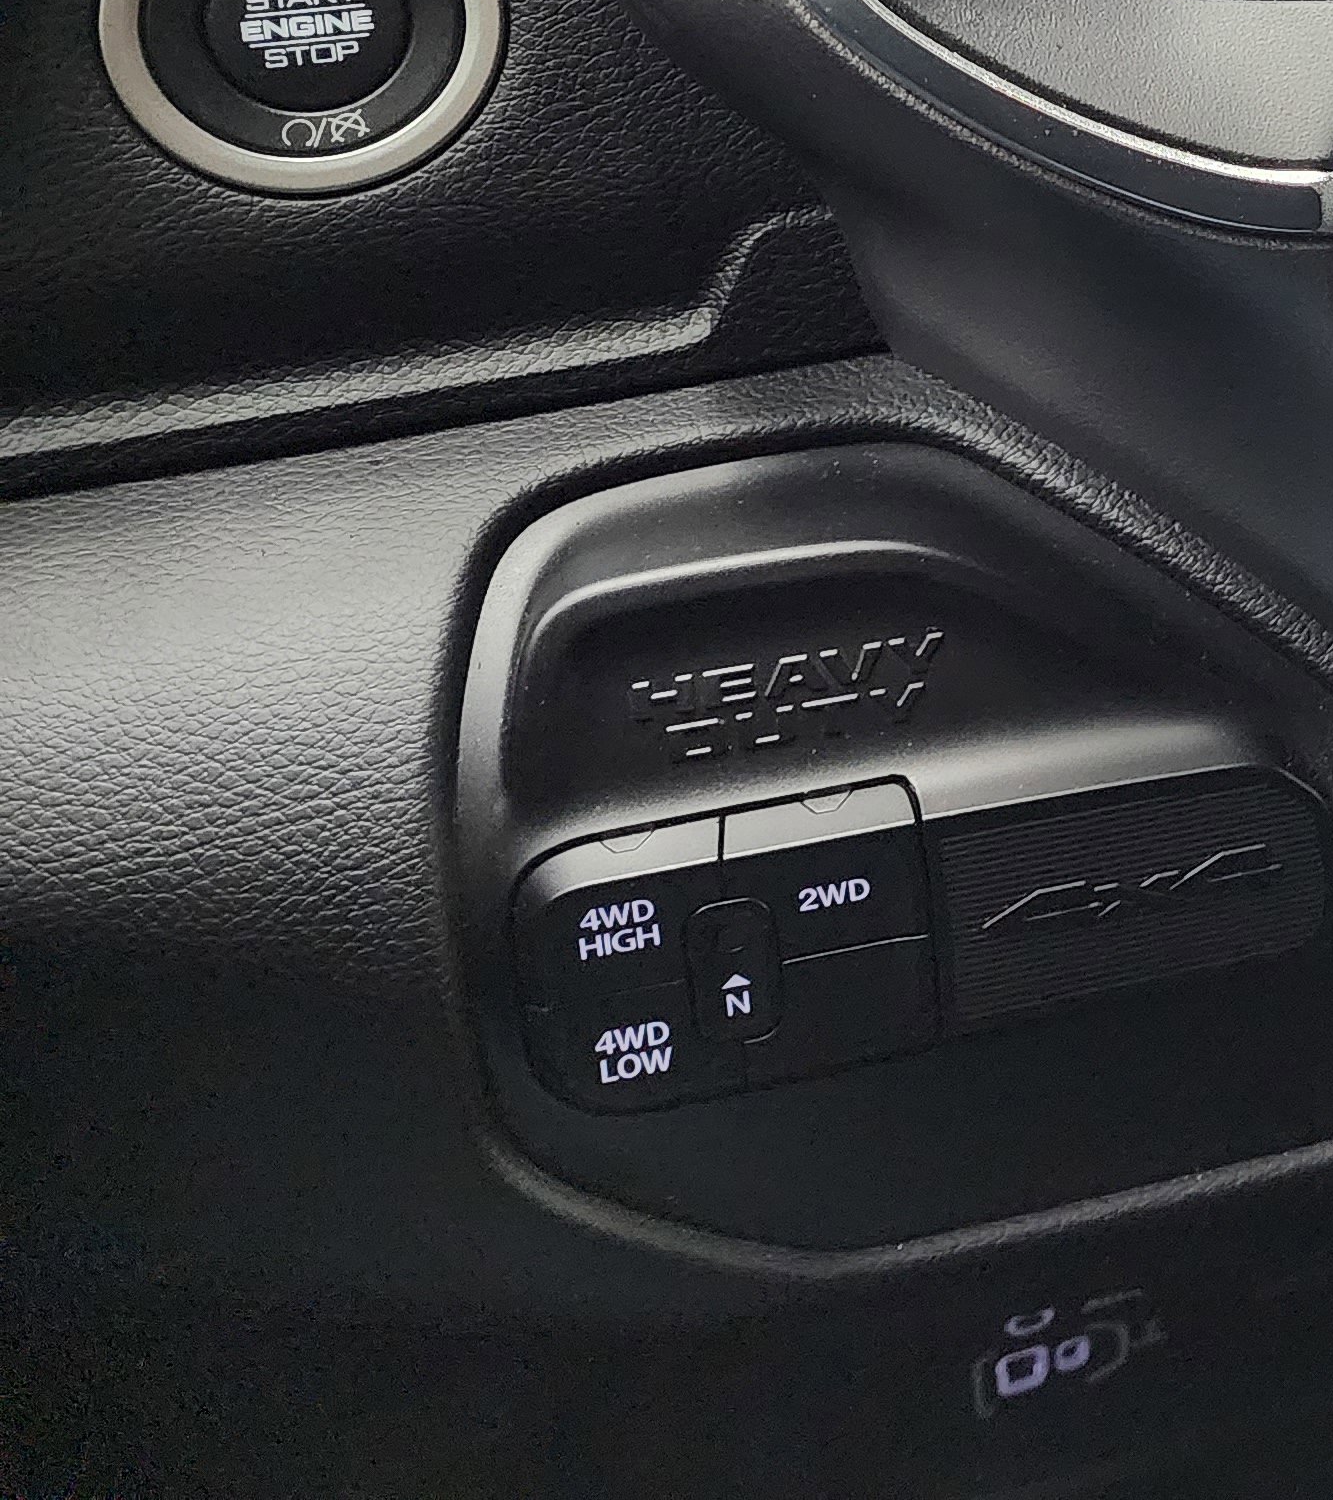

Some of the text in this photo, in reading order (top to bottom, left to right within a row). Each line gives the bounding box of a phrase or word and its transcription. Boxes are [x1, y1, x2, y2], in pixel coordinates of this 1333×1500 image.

[240, 8, 374, 43] ENGINE
[264, 40, 359, 69] STOP
[798, 878, 871, 912] 2WD
[579, 899, 655, 931] 4WD
[578, 924, 661, 961] HIGH
[725, 990, 751, 1017] N
[594, 1021, 670, 1055] 4WD
[599, 1047, 672, 1084] LOW
